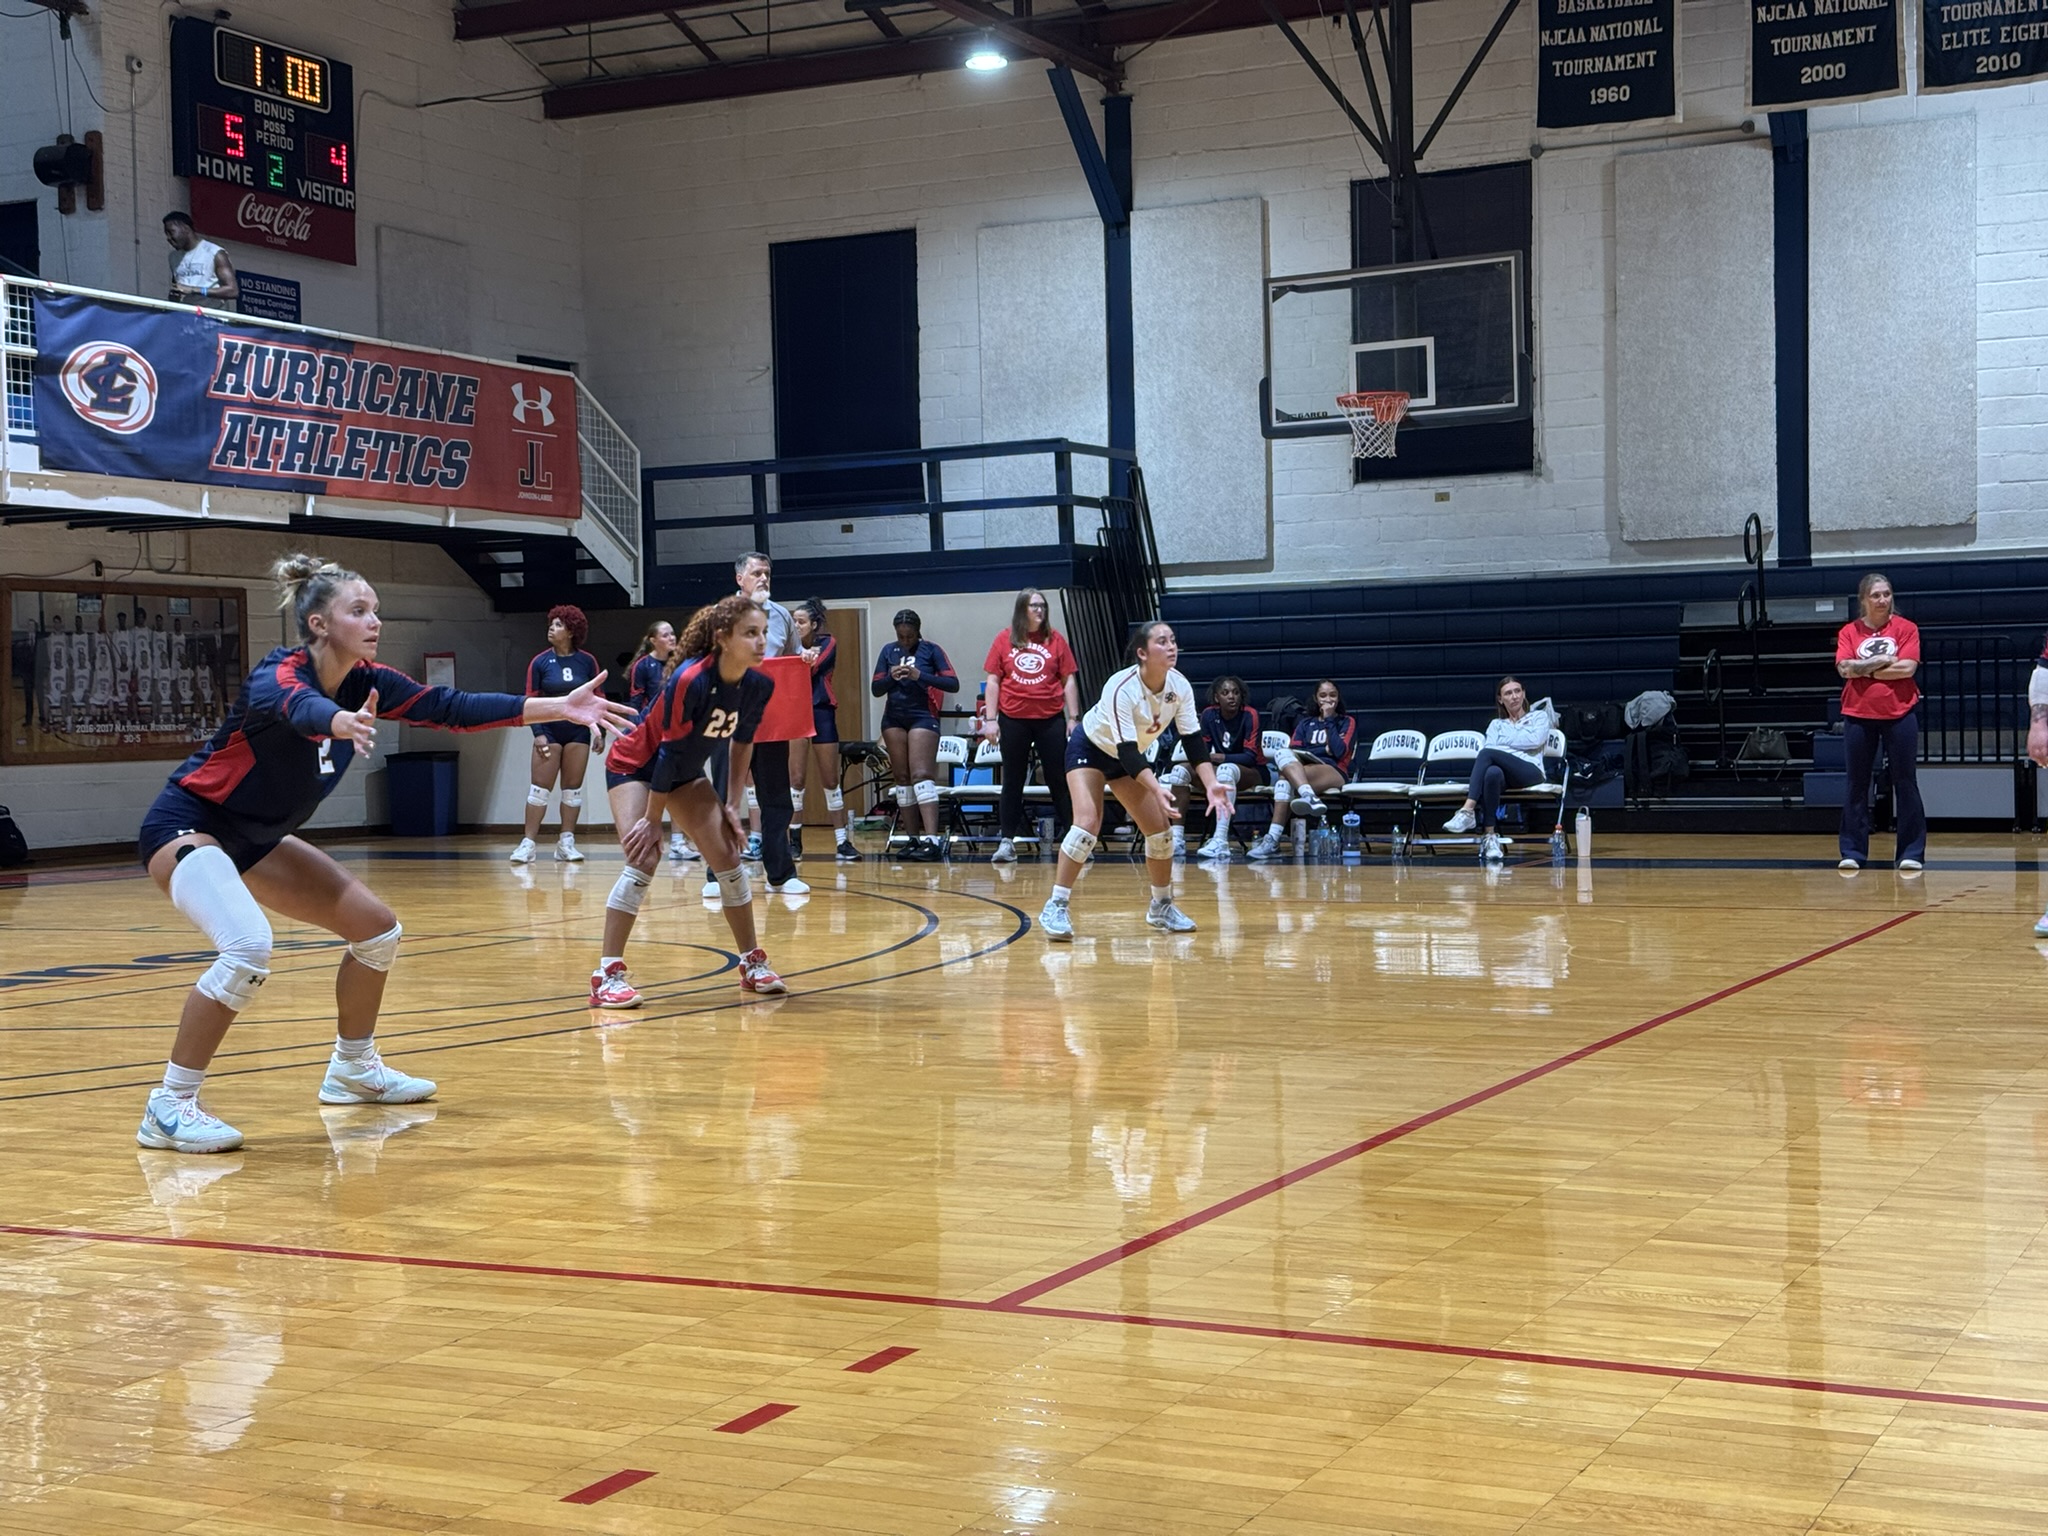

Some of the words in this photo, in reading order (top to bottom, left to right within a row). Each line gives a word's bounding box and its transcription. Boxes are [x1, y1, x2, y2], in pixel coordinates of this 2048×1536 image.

[1557, 0, 1654, 14] BASKET
[1757, 2, 1808, 24] NJCAA
[1541, 26, 1586, 47] NJCAA
[1589, 16, 1663, 43] NATIONAL
[1771, 25, 1877, 55] TOURNAMENT
[1941, 27, 1991, 51] ELITE
[2000, 21, 2048, 44] EIGHT
[1552, 50, 1657, 77] TOURNAMENT
[1800, 62, 1847, 84] 2000
[1976, 51, 2022, 74] 2010
[1590, 85, 1631, 105] 1960
[254, 98, 295, 123] BONUS
[224, 112, 244, 158] 5
[263, 119, 286, 135] POSS
[256, 130, 294, 151] PERIOD
[197, 154, 254, 187] HOME
[268, 153, 284, 188] 2
[330, 143, 347, 184] 4
[297, 177, 355, 210] VISITOR
[241, 277, 254, 289] NO
[255, 280, 297, 298] STANDING
[242, 294, 267, 306] Access
[267, 298, 297, 312] Corridors
[244, 304, 253, 314] To
[254, 307, 278, 318] Remain
[278, 311, 295, 321] Clear
[210, 338, 480, 427] HURRICANE
[212, 410, 472, 490] ATHLETICS
[562, 667, 573, 682] 8
[703, 708, 738, 738] 23
[1310, 729, 1327, 744] 10
[1376, 734, 1420, 752] LOUISBURG
[1434, 735, 1480, 753] LOUISBURG
